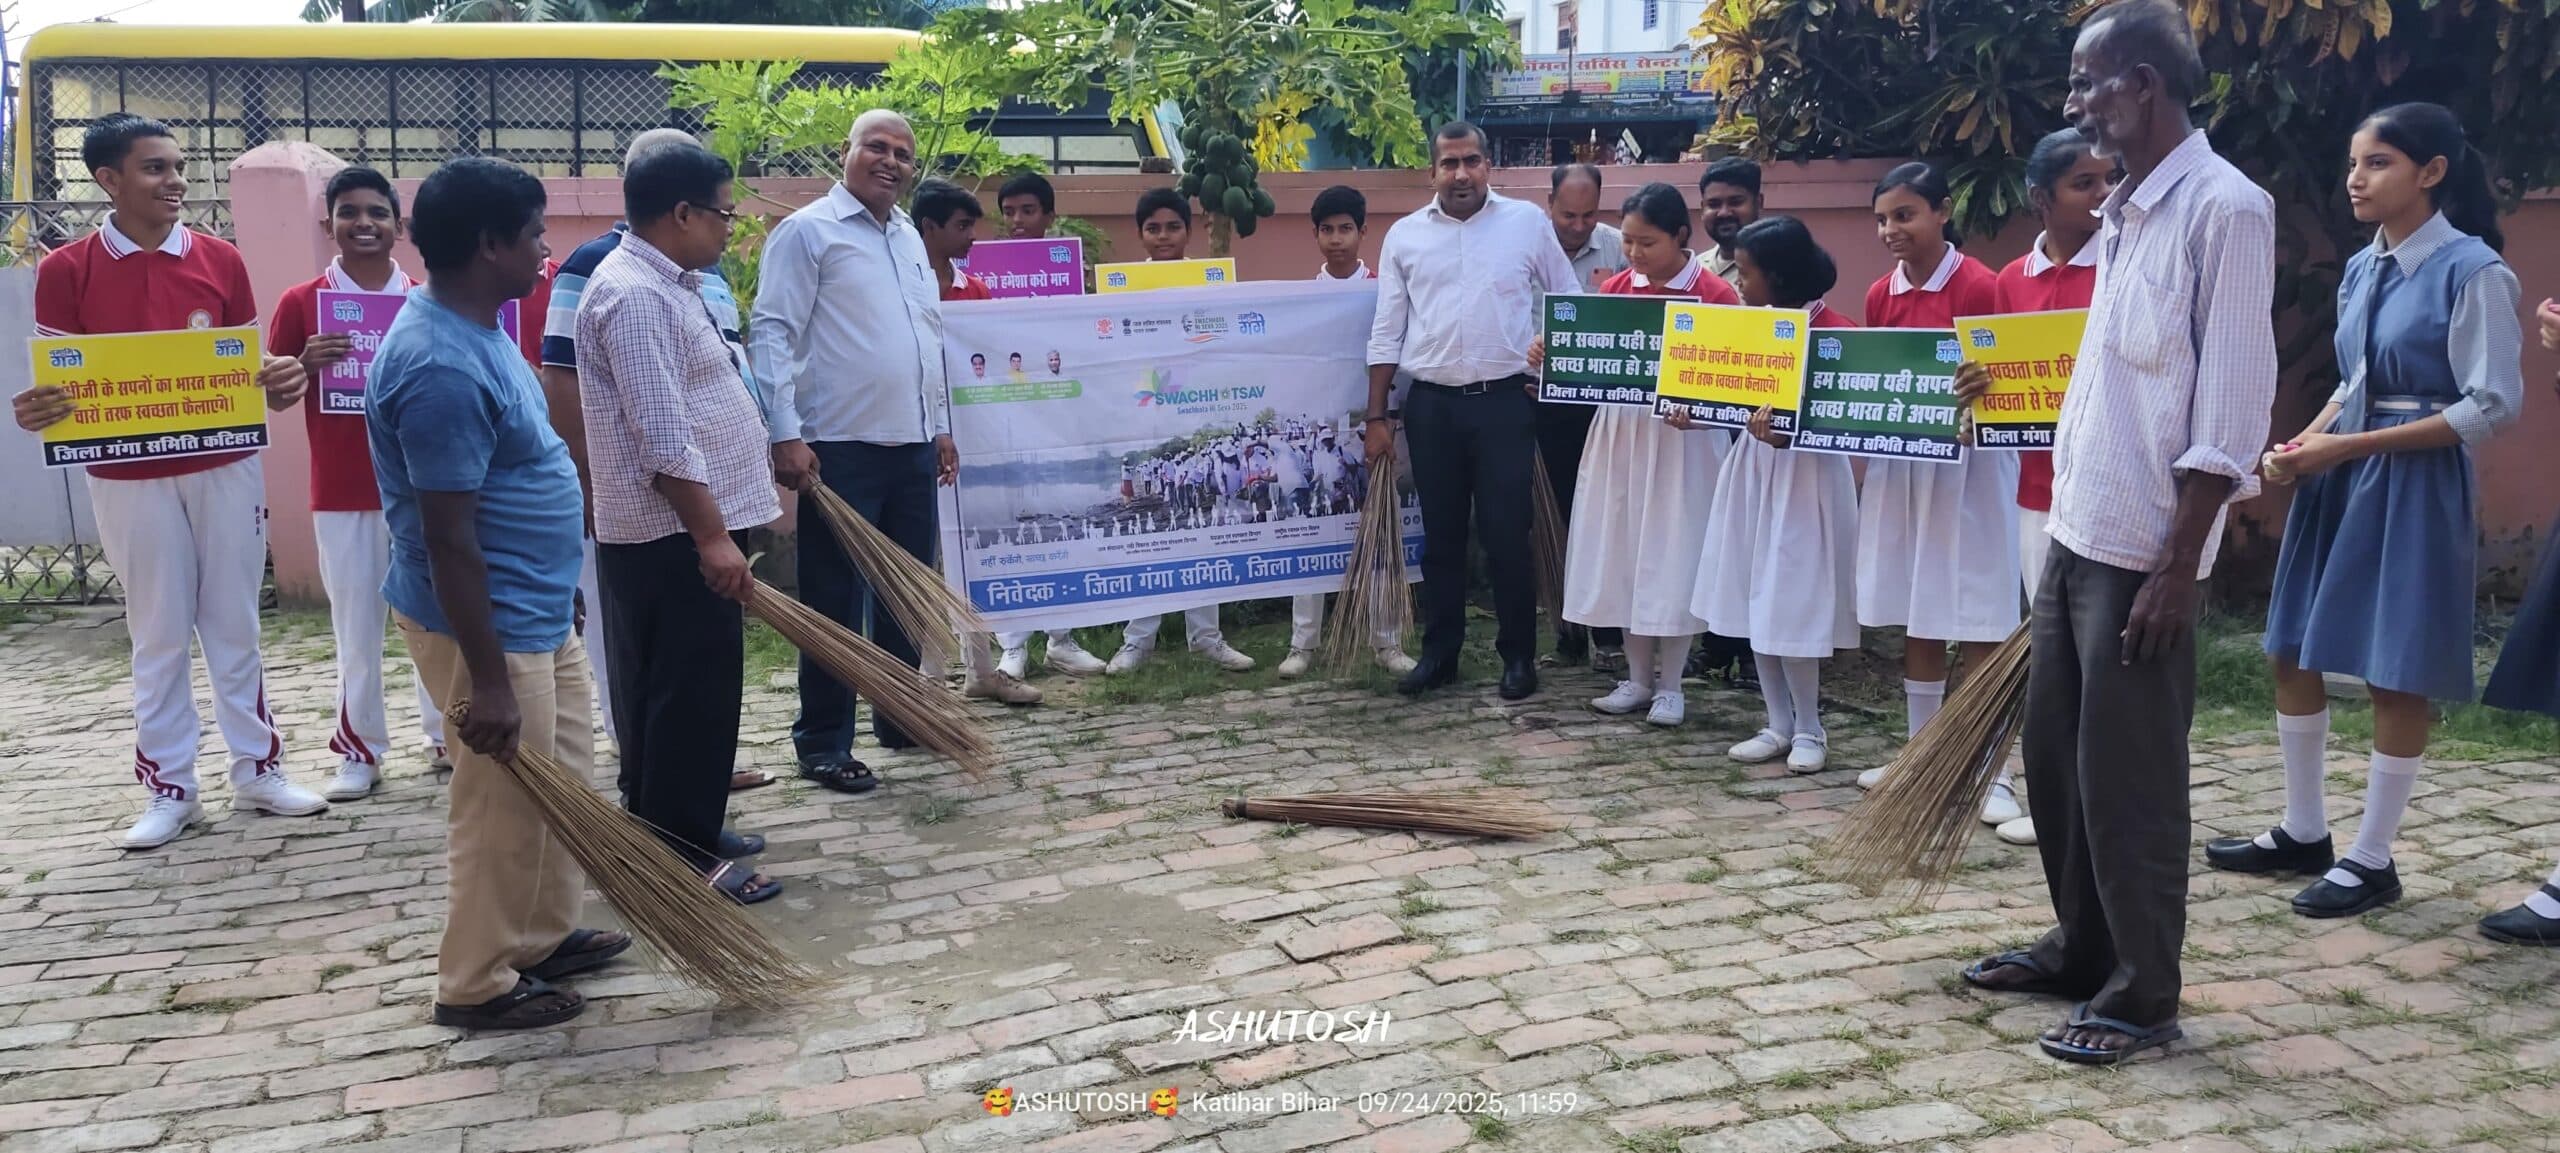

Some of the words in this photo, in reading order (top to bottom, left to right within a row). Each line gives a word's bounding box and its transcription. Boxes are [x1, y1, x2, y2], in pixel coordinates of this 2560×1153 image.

[1001, 273, 1028, 289] हमेशा
[1030, 270, 1047, 288] करो
[1050, 272, 1070, 286] मान
[1551, 332, 1571, 348] हम
[1576, 332, 1614, 350] सबका
[1616, 330, 1645, 350] यही
[1550, 356, 1584, 374] स्वच्छ
[1588, 358, 1621, 375] भारत
[1625, 354, 1641, 376] हो
[1670, 343, 1696, 361] गांधीजी
[1699, 345, 1706, 361] के
[1709, 346, 1731, 365] सपनों
[1732, 352, 1742, 366] का
[1744, 353, 1763, 368] भारत
[332, 359, 360, 379] तभी
[1679, 366, 1696, 384] चारों
[1697, 372, 1714, 386] तरफ
[1716, 374, 1743, 389] स्वच्छता
[2032, 361, 2051, 379] का
[101, 379, 114, 397] के
[118, 375, 153, 396] सपनों
[155, 378, 172, 393] का
[176, 375, 205, 391] भारत
[1813, 371, 1833, 389] हम
[1838, 372, 1878, 392] सबका
[1882, 369, 1912, 393] यही
[1546, 384, 1577, 399] जिला
[1580, 387, 1604, 400] गंगा
[1606, 386, 1642, 402] समिति
[1982, 392, 2025, 411] स्वच्छता
[2029, 386, 2040, 410] से
[74, 403, 100, 424] चारों
[105, 406, 131, 422] तरफ
[136, 403, 179, 420] स्वच्छता
[1692, 404, 1713, 418] गंगा
[1716, 408, 1751, 423] समिति
[1810, 400, 1845, 419] स्वच्छ
[1846, 402, 1884, 421] भारत
[1887, 398, 1904, 423] हो
[1907, 406, 1956, 425] अपना
[53, 445, 101, 461] जिला
[106, 440, 141, 456] गंगा
[146, 434, 199, 452] समिति
[203, 430, 260, 447] कटिहार
[1800, 432, 1831, 447] जिला
[1834, 433, 1860, 449] गंगा
[1862, 436, 1903, 453] समिति
[1905, 437, 1954, 457] कटिहार
[1982, 428, 2018, 444] जिला
[2021, 426, 2050, 444] गंगा
[987, 577, 1054, 607] निवेदक
[1084, 571, 1132, 597] जिला
[1139, 565, 1176, 593] गंगा
[1180, 561, 1240, 587] समिति,
[1247, 553, 1291, 579] जिला
